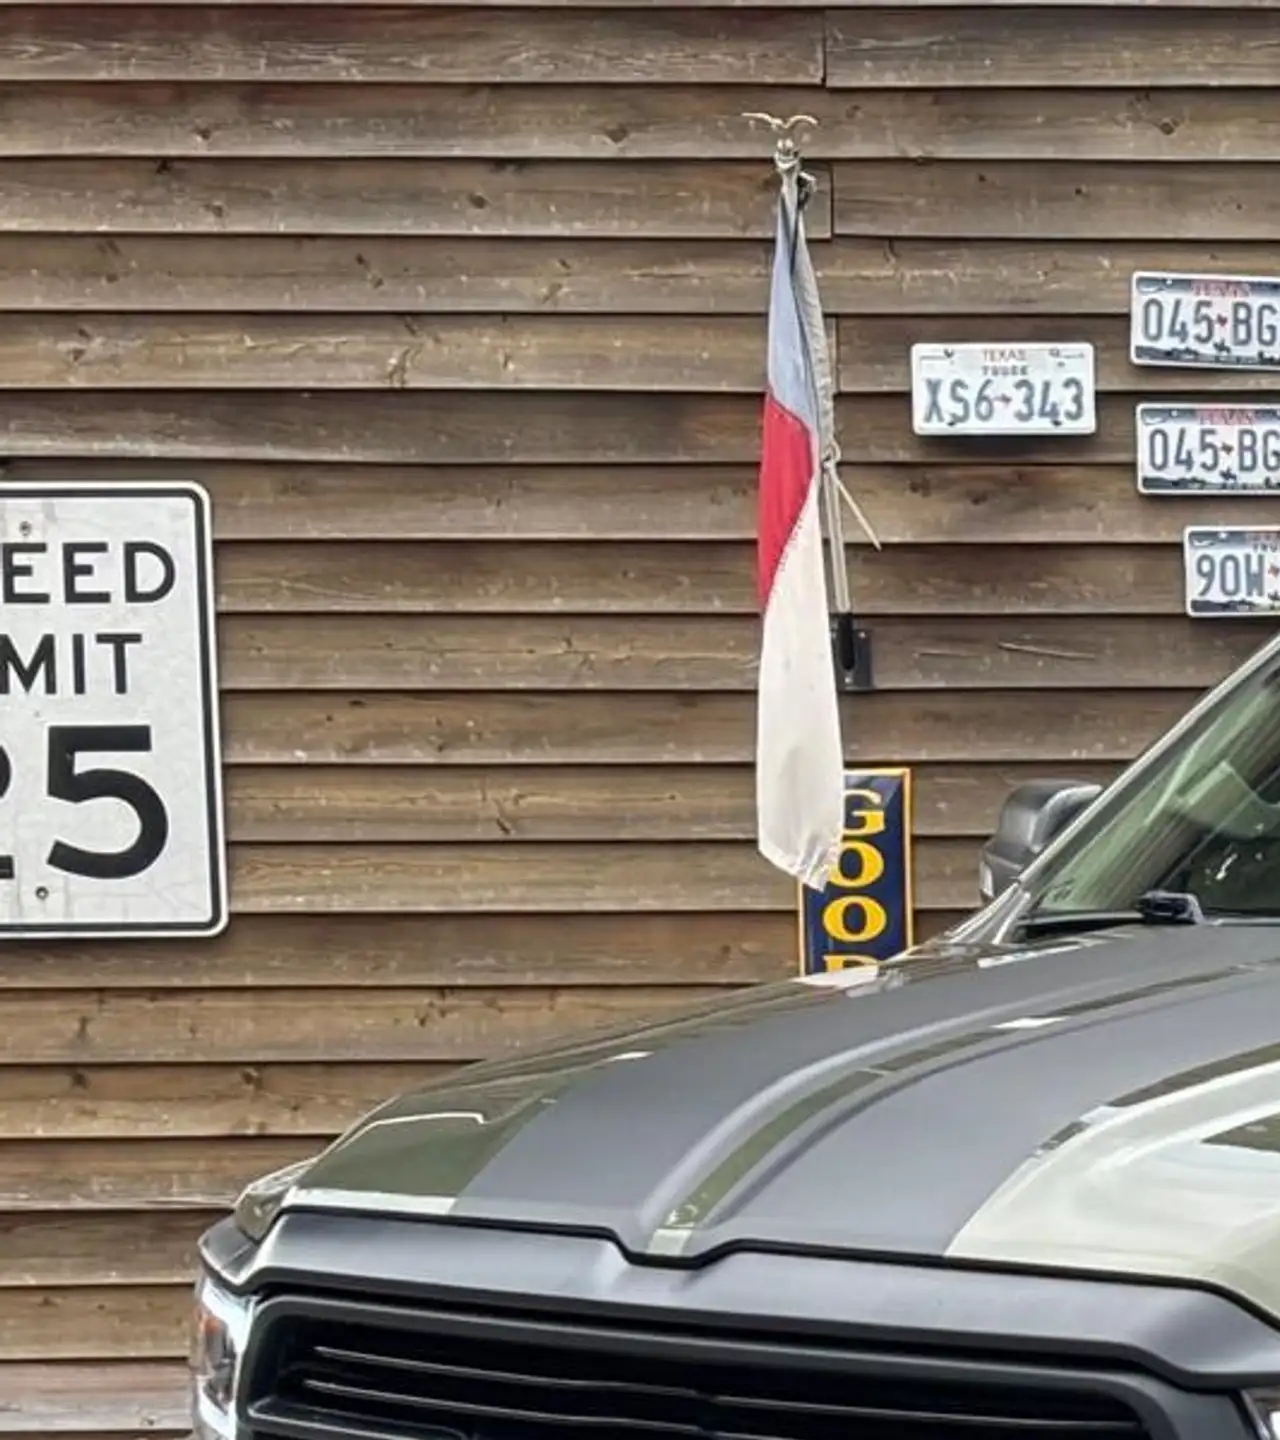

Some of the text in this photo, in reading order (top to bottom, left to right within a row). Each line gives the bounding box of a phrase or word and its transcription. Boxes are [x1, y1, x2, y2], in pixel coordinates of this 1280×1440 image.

[983, 349, 1027, 361] TEXAS
[1013, 377, 1084, 421] 343
[0, 724, 170, 880] 5
